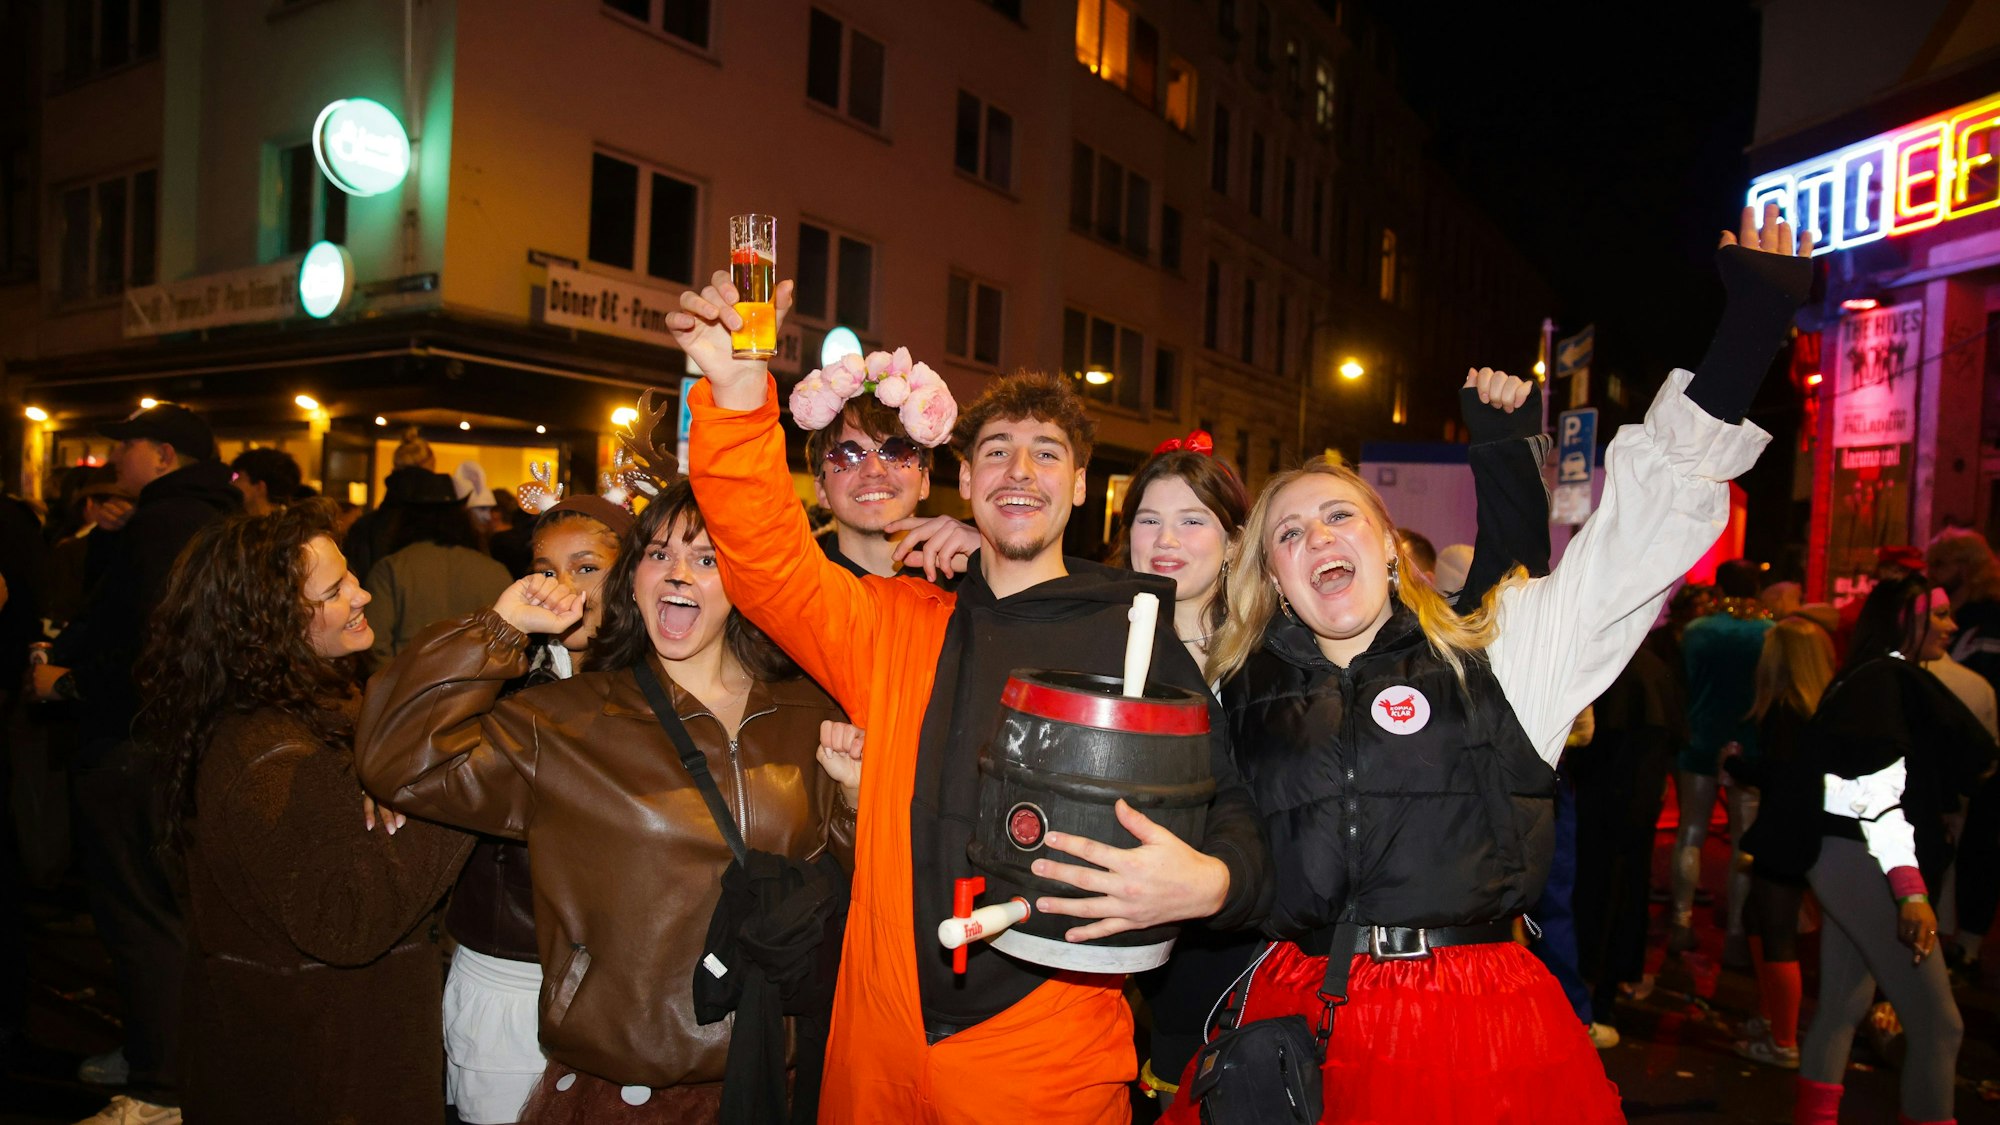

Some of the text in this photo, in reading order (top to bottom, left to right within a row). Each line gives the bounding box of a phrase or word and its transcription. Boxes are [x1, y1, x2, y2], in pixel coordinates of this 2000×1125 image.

[550, 280, 597, 317] Döner
[600, 290, 619, 323] 8€
[1844, 309, 1921, 342] THE HIVES
[1563, 415, 1581, 447] P
[1843, 417, 1907, 434] PALLADIUM
